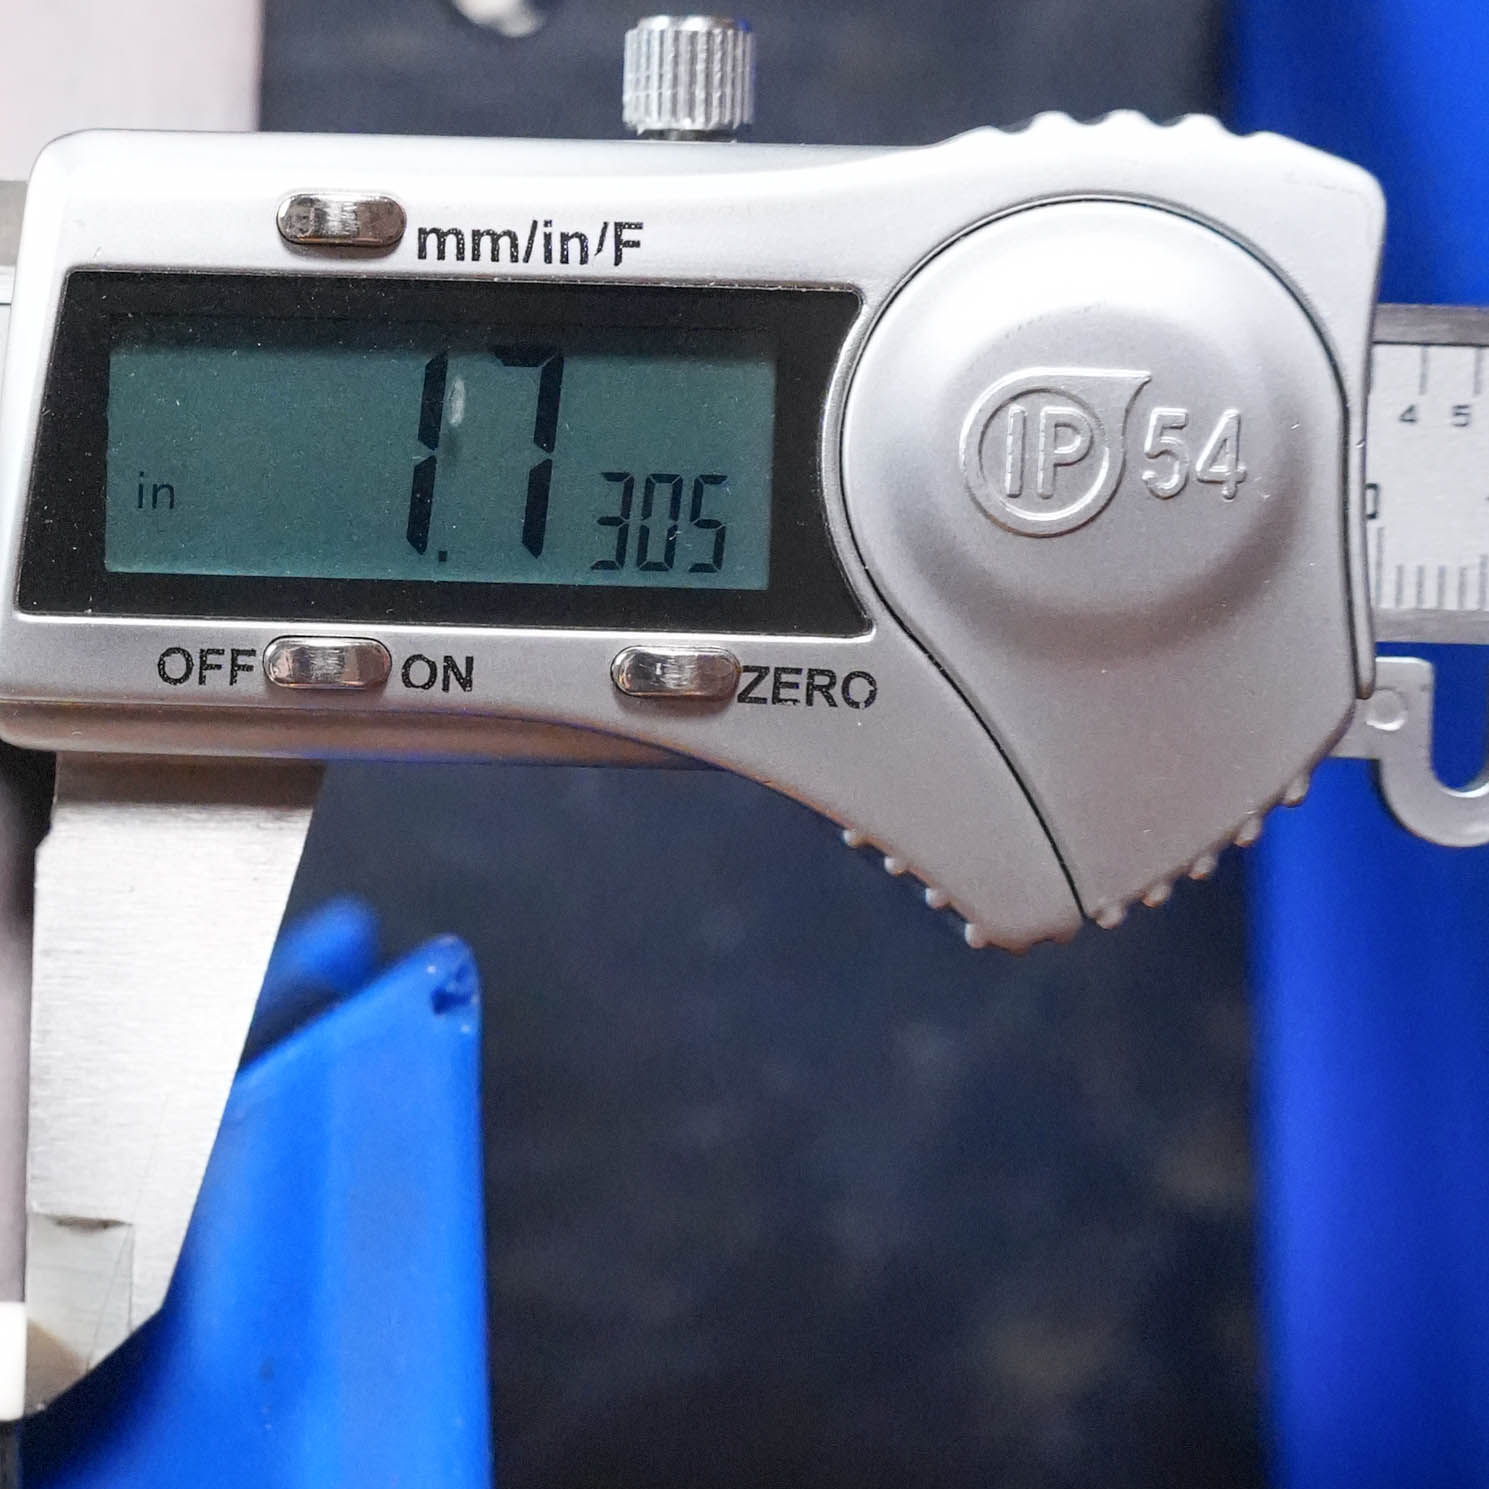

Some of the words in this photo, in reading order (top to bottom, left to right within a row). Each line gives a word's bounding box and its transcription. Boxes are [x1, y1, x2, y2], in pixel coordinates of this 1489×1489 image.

[416, 218, 645, 267] mm/in/F
[1396, 402, 1421, 427] 4
[1449, 402, 1475, 430] 5
[1003, 404, 1094, 500] IP
[1142, 407, 1248, 502] 54
[136, 469, 176, 511] in
[156, 646, 258, 686] OFF
[401, 653, 475, 693] ON
[737, 664, 879, 710] ZERO
